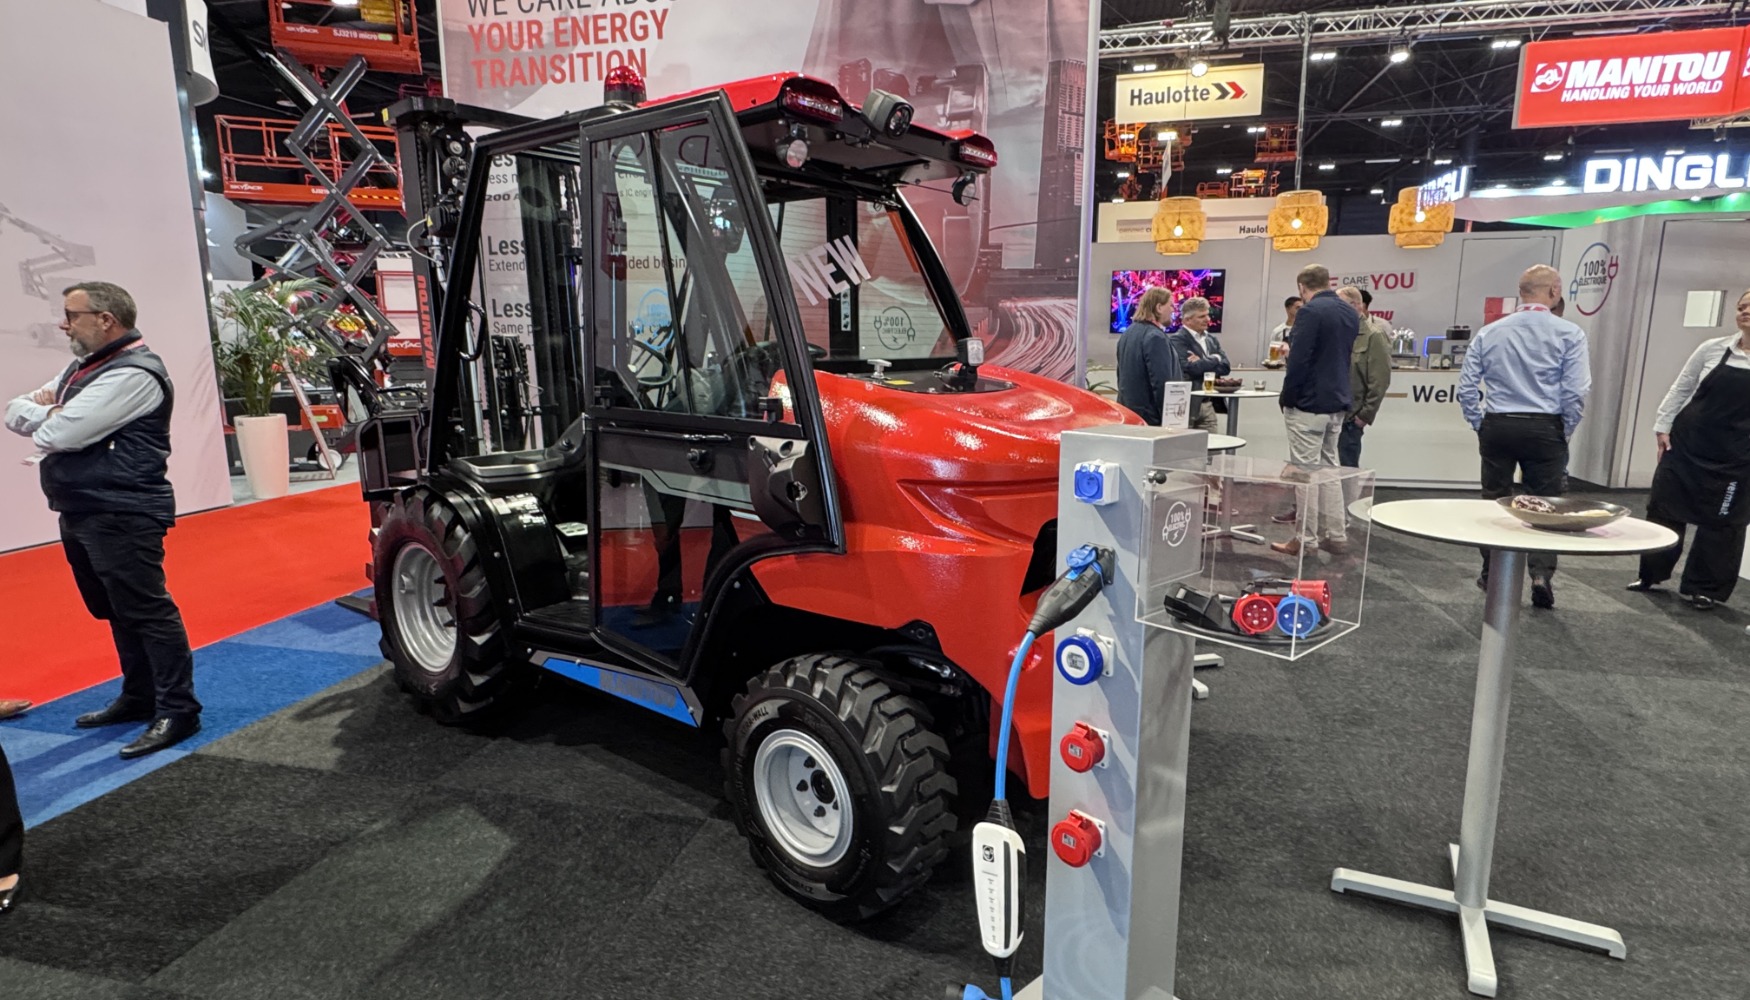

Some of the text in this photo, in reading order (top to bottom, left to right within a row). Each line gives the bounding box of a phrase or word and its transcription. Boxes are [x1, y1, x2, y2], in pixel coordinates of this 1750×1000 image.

[358, 31, 378, 41] micro
[468, 8, 669, 53] YOUR ENERGY
[1565, 51, 1731, 88] MANITOU
[1130, 85, 1211, 106] Haulotte
[1561, 80, 1723, 102] HANDLING YOUR WORLD
[1583, 154, 1750, 193] DINGL
[784, 234, 871, 306] NEW
[1584, 260, 1607, 277] 100%
[1343, 276, 1369, 285] CARE
[1370, 272, 1414, 290] YOU
[416, 275, 435, 369] MANITOU
[493, 321, 523, 333] Same
